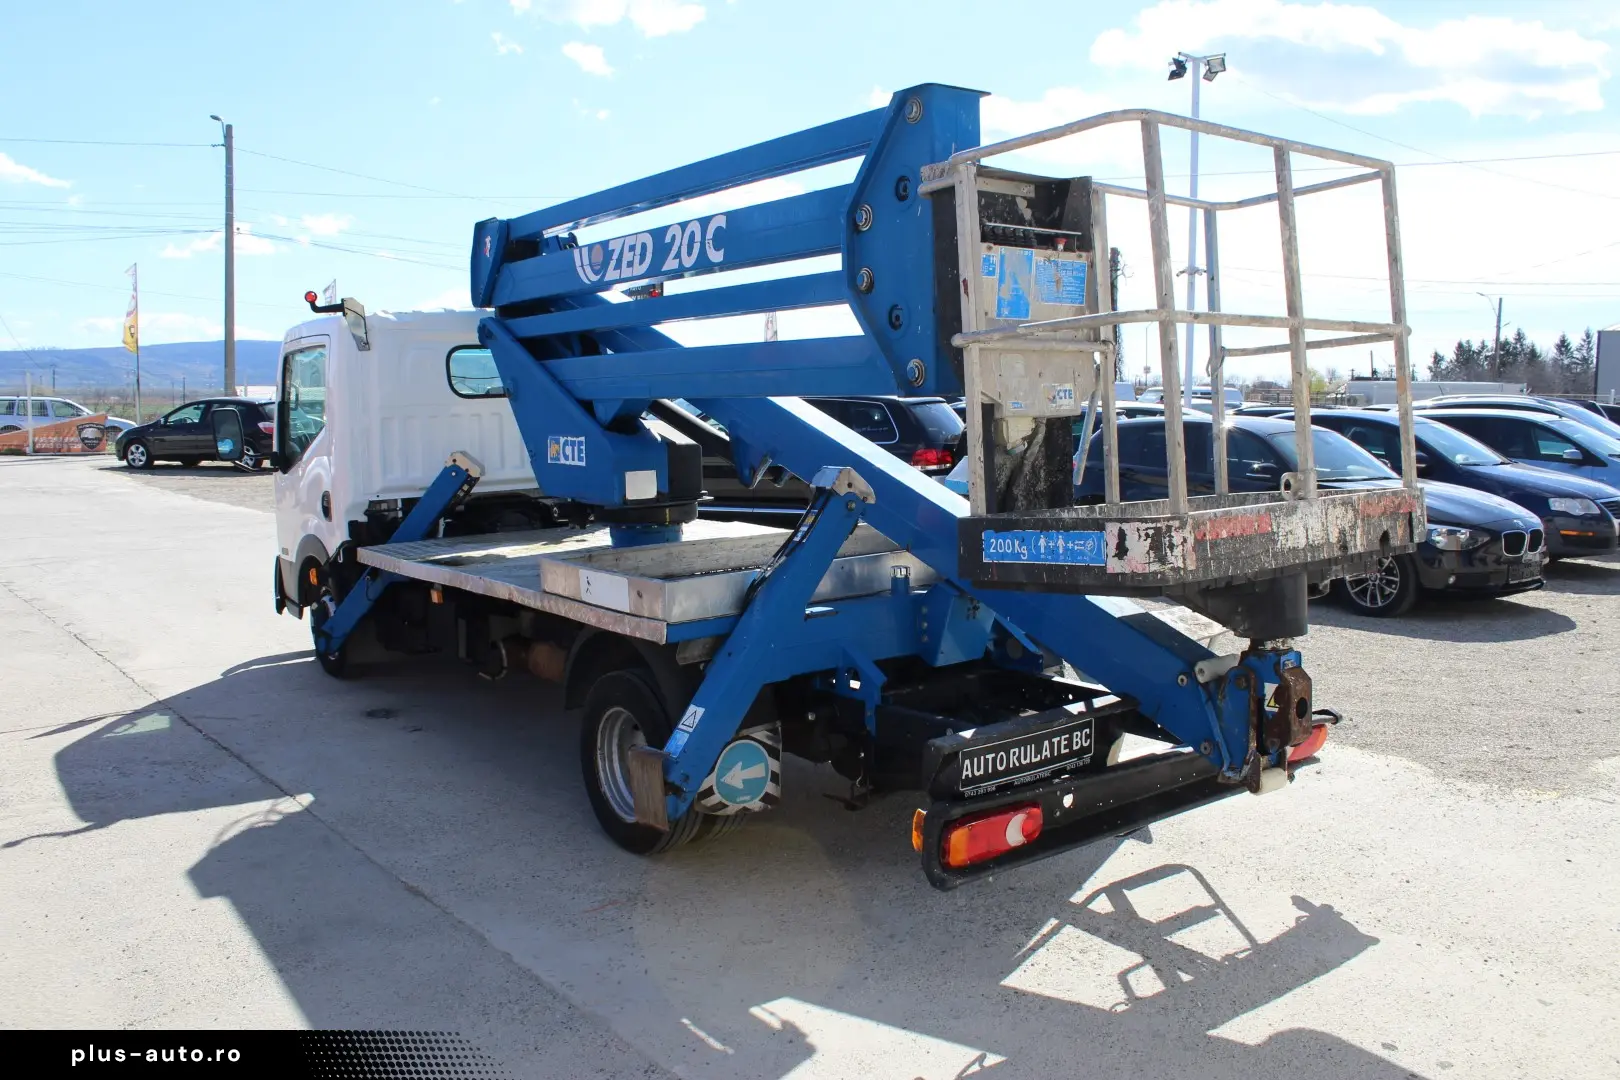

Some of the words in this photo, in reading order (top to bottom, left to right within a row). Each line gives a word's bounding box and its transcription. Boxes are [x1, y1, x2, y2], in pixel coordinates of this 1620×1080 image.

[604, 232, 654, 281] ZED
[1056, 388, 1073, 400] CTE
[561, 439, 585, 463] CTE
[1072, 728, 1090, 751] BC
